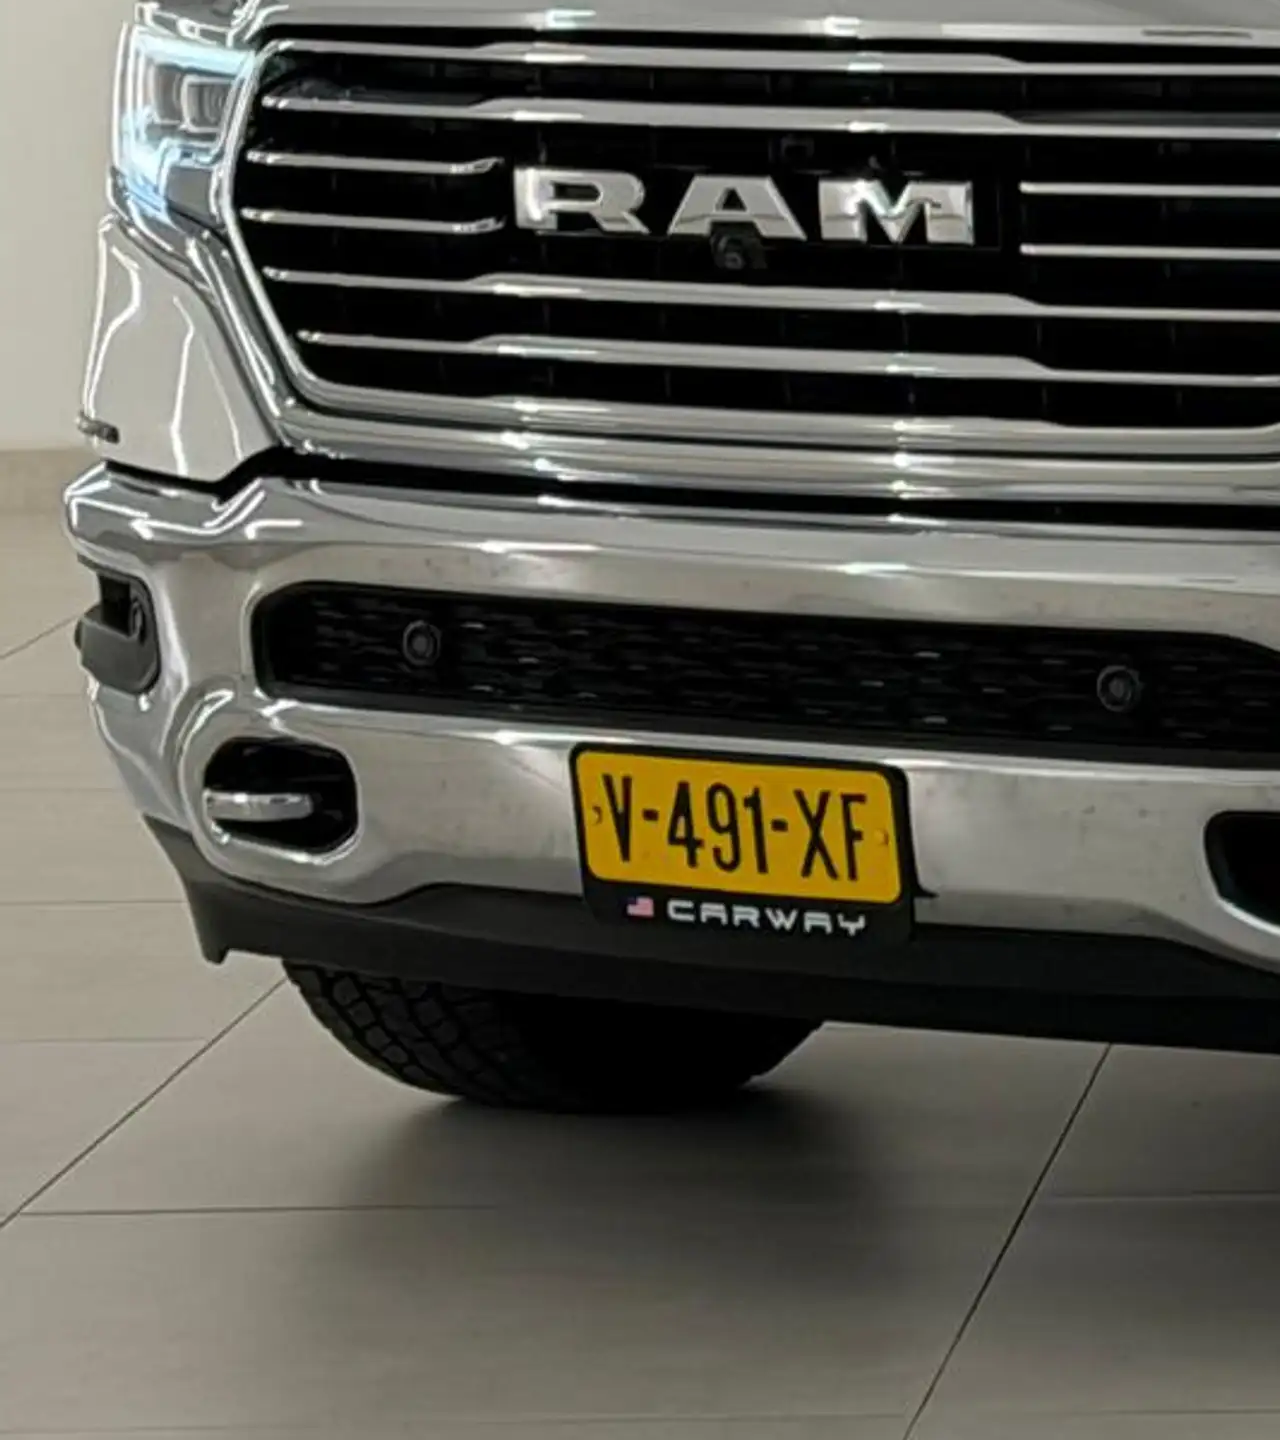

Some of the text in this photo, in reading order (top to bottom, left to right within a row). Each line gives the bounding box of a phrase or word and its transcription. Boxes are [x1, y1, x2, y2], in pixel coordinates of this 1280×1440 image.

[513, 167, 975, 247] RAM
[602, 773, 867, 882] V-491-XF
[667, 900, 866, 937] CARWAY
